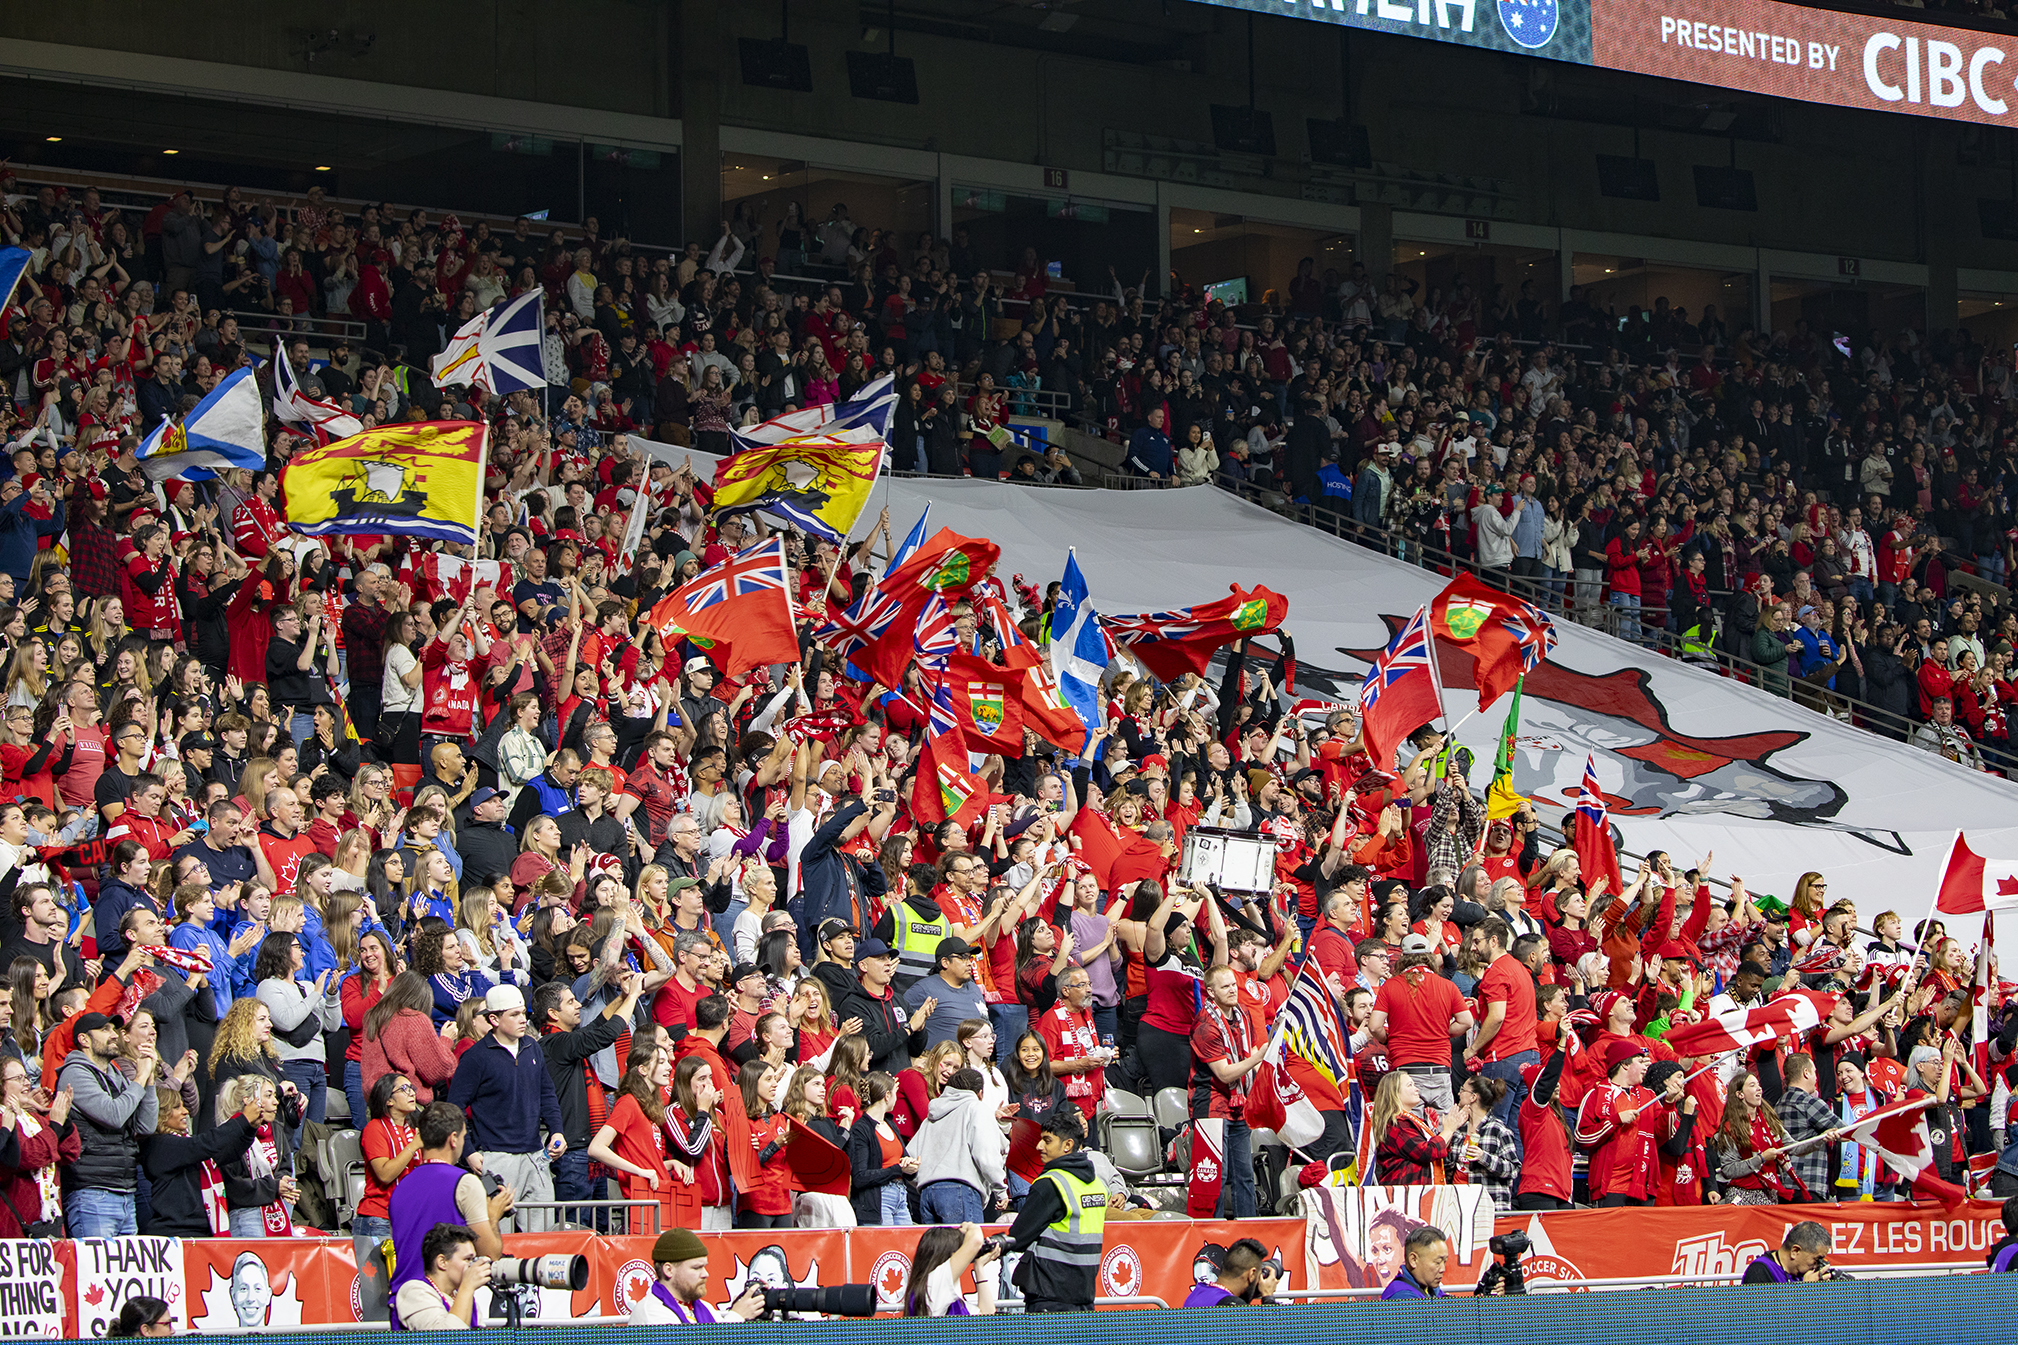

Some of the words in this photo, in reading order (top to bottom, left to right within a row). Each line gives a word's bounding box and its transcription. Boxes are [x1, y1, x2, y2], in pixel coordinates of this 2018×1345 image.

[1661, 16, 1801, 65] PRESENTED
[1808, 41, 1840, 71] BY
[1863, 32, 2009, 115] CIBC
[1050, 170, 1062, 186] 16
[1472, 222, 1484, 237] 14
[1844, 259, 1855, 274] 12
[1327, 481, 1352, 493] HOSTING
[1371, 1055, 1389, 1072] 16
[1196, 1167, 1218, 1175] CANADA
[1873, 1220, 1922, 1254] LES
[1930, 1218, 2005, 1253] ROUG
[16, 1242, 56, 1278] FOR
[85, 1239, 173, 1274] THANK
[548, 1270, 565, 1279] NOT
[1521, 1260, 1557, 1278] OCCER
[104, 1277, 165, 1312] YOU
